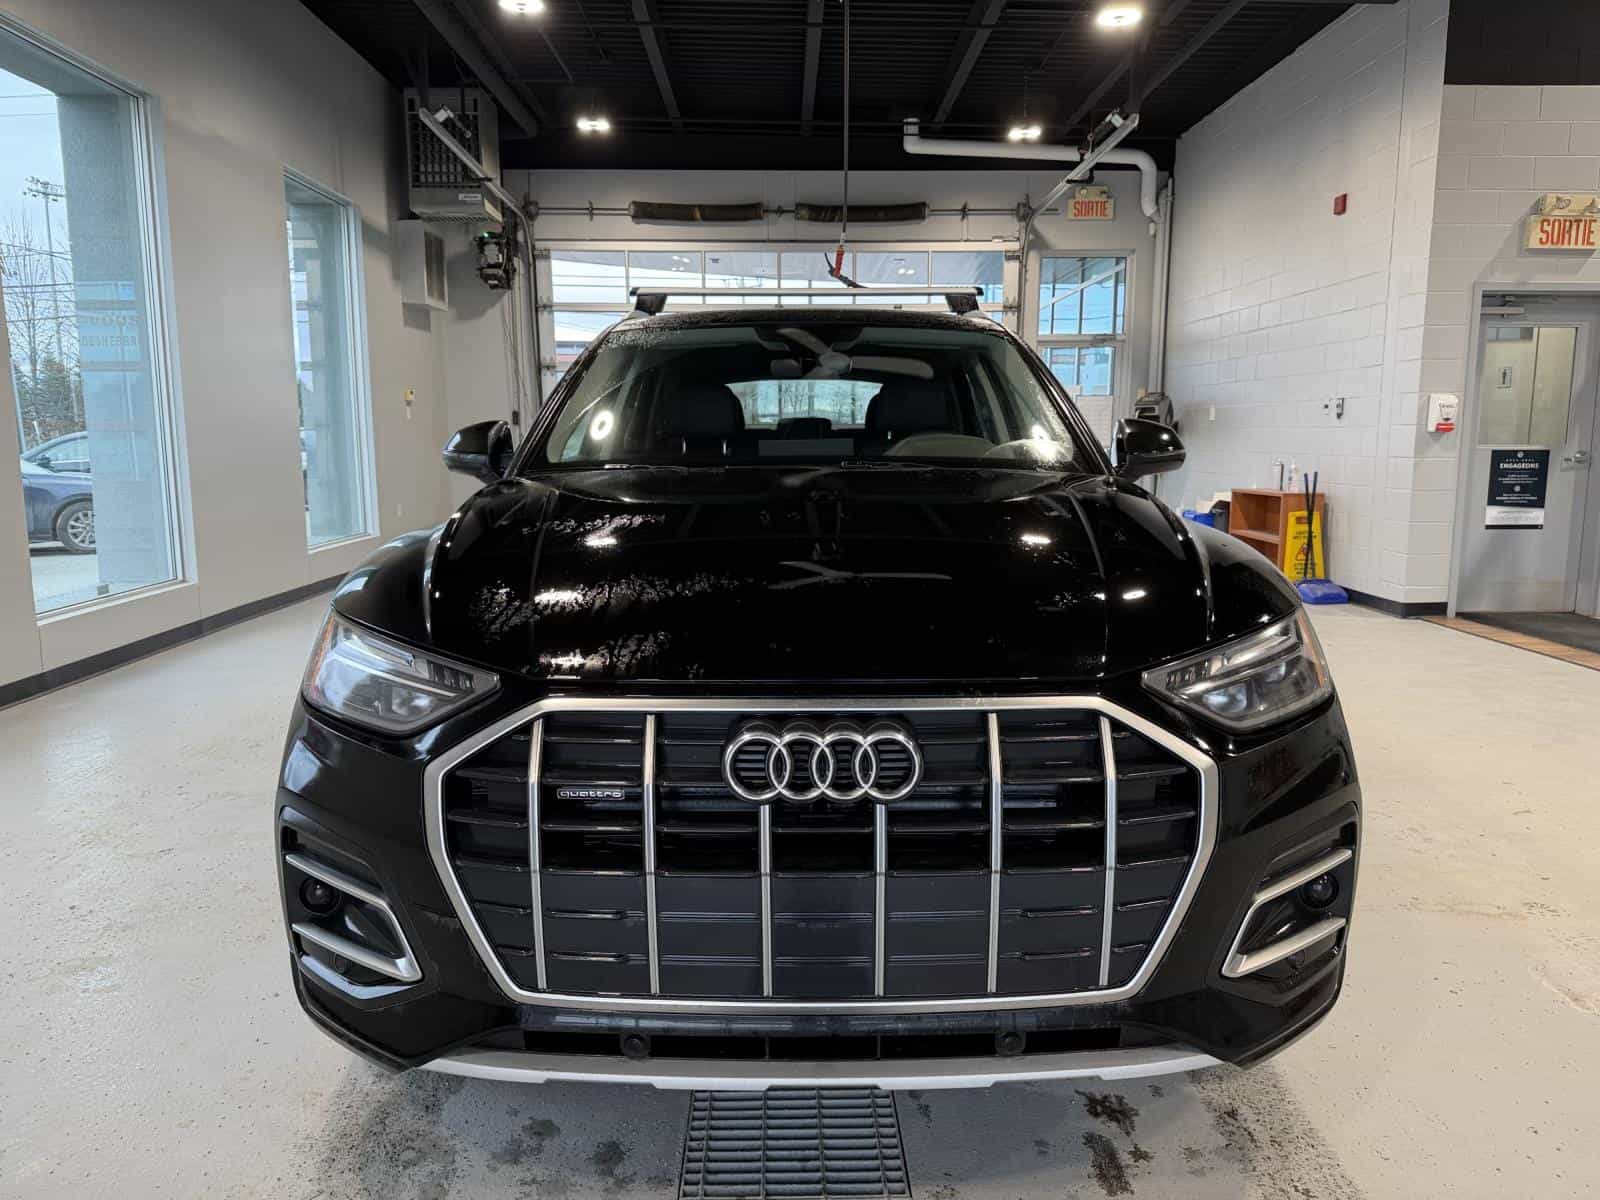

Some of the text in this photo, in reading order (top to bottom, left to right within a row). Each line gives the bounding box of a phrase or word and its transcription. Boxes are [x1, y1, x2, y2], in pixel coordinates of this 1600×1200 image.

[1073, 200, 1109, 217] SORTIE
[1539, 218, 1597, 246] SORTIE
[559, 790, 622, 799] quattro
